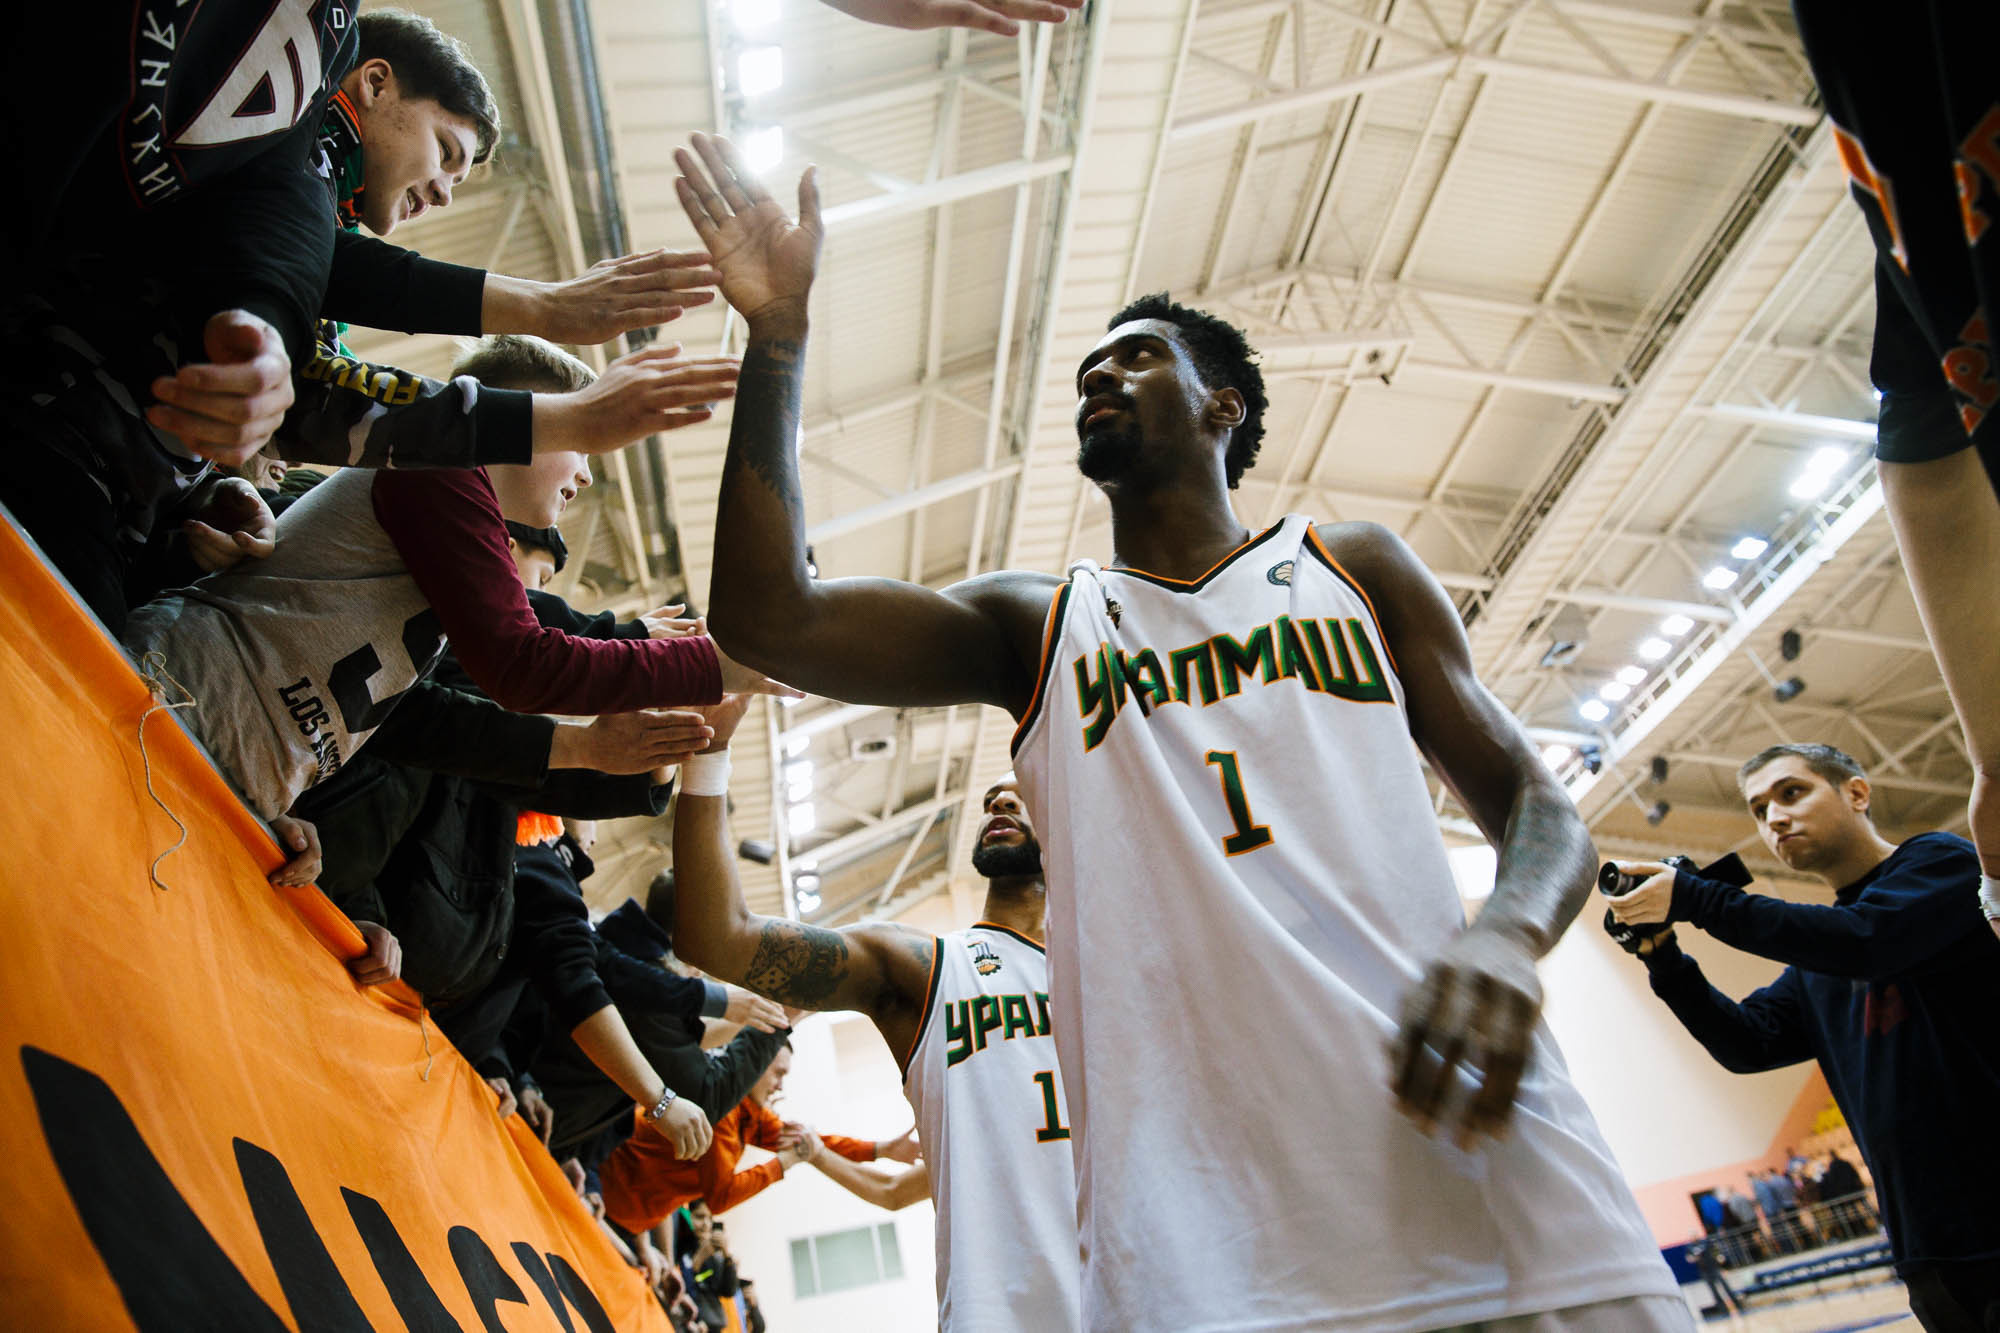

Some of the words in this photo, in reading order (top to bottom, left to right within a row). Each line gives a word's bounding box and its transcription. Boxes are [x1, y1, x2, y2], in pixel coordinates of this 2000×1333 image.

[278, 676, 330, 737] LOS
[1205, 749, 1275, 858] 1
[1032, 1070, 1072, 1144] 1
